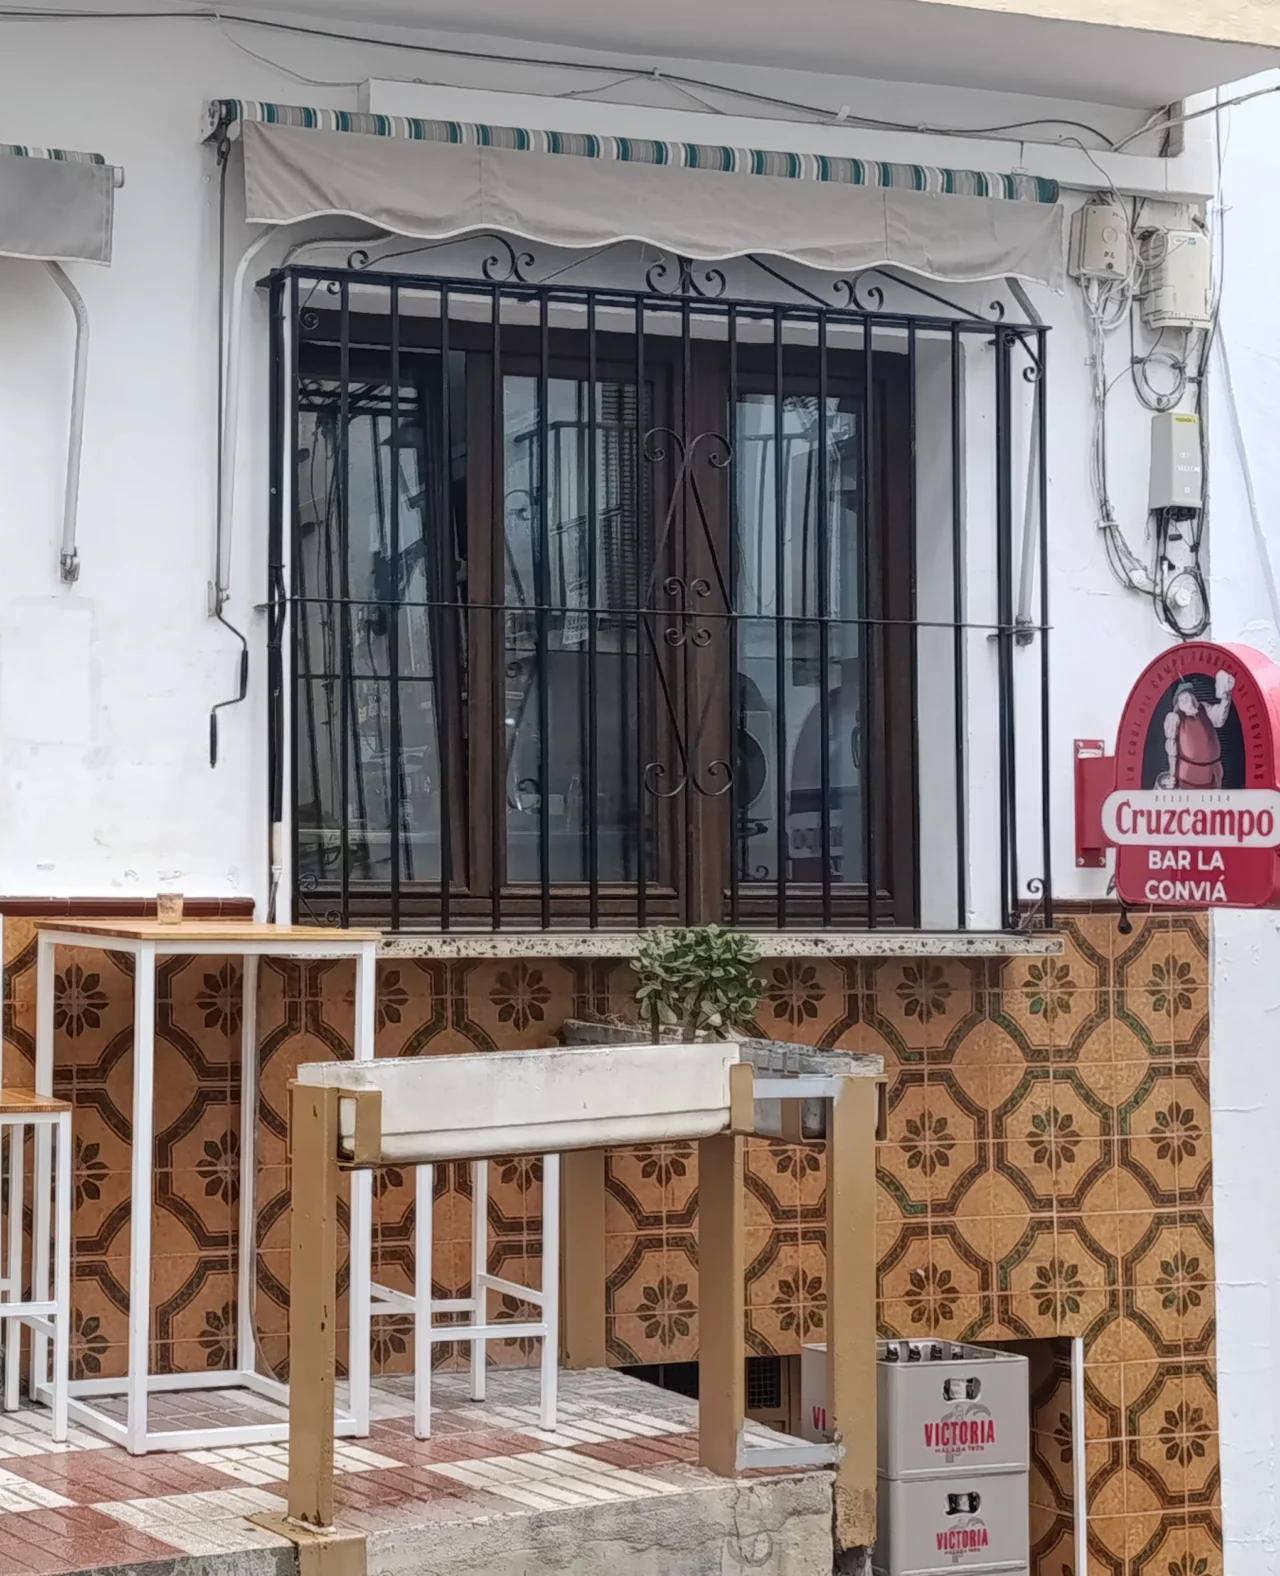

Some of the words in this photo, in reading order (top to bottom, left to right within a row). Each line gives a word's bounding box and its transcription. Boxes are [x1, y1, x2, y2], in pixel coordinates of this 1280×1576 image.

[1115, 799, 1274, 843] Cruzcampo
[1148, 850, 1190, 870] BAR
[1197, 850, 1225, 870] LA
[1144, 875, 1228, 901] CONVIÁ
[924, 1420, 995, 1447] VICTORIA
[936, 1528, 988, 1551] VICTORIA
